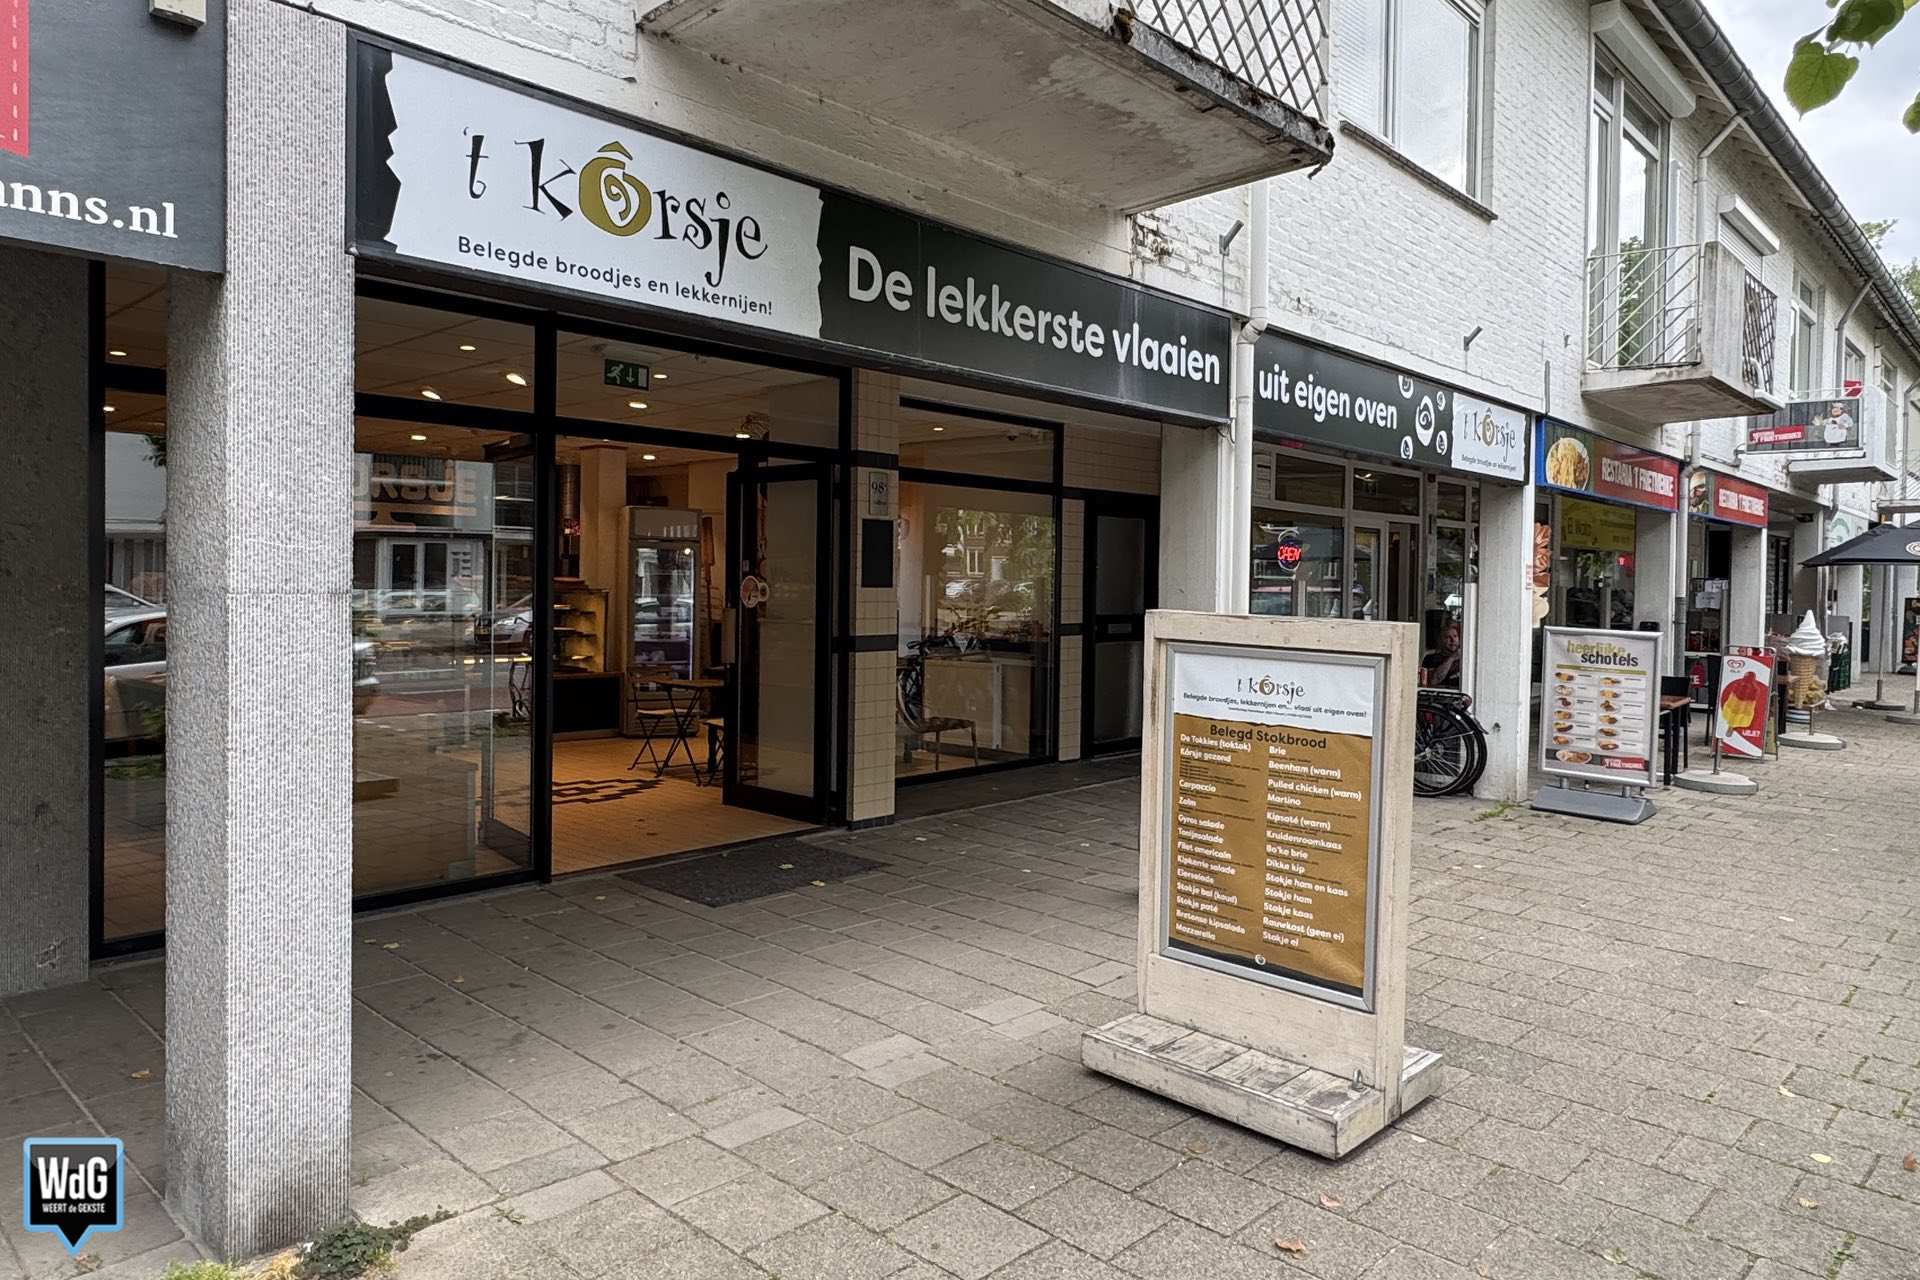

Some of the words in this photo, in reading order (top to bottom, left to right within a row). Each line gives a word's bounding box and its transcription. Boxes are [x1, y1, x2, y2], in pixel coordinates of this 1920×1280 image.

[0, 179, 178, 239] nns.nl
[458, 236, 548, 269] Belegde
[555, 255, 641, 289] broodjes
[648, 278, 669, 295] en
[675, 280, 773, 316] lekkernijen!
[848, 245, 913, 312] De
[926, 265, 1105, 358] lekkerste
[1112, 321, 1221, 385] vlaaien
[1258, 363, 1290, 404] uit
[1294, 373, 1350, 423] eigen
[1354, 396, 1398, 430] oven
[1278, 545, 1302, 561] OPEN
[1580, 650, 1639, 667] schotels
[1183, 692, 1207, 702] Belegde
[1324, 708, 1345, 717] eigen
[1346, 709, 1367, 718] oven!
[1180, 734, 1190, 742] De
[1210, 724, 1253, 741] Belegd
[1256, 730, 1327, 749] Stokbrood
[1203, 752, 1232, 763] gezond
[1269, 745, 1286, 755] Brie
[1268, 760, 1309, 772] Beenham
[1310, 765, 1341, 779] (warm)
[1179, 779, 1216, 793] Carpaccio
[1268, 779, 1294, 790] Pulled
[1295, 782, 1329, 795] chicken
[1331, 788, 1362, 801] (warm)
[1179, 796, 1196, 807] Zalm
[1267, 793, 1301, 806] Martino
[1178, 814, 1197, 825] Gyros
[1199, 819, 1225, 830] salade
[1300, 817, 1331, 831] (warm)
[1178, 841, 1193, 851] Filet
[1266, 830, 1342, 850] Kruidenroomkaas
[1290, 848, 1308, 859] brie
[1210, 863, 1236, 875] salade
[1266, 858, 1289, 870] Dikke
[1291, 863, 1305, 874] kip
[1177, 882, 1200, 895] Stokje
[1265, 873, 1292, 887] Stokje
[1294, 879, 1313, 890] ham
[1314, 884, 1325, 893] en
[1327, 885, 1348, 897] kaas
[1176, 895, 1199, 909] Stokje
[1265, 887, 1292, 901] Stokje
[1293, 893, 1312, 904] ham
[1264, 902, 1291, 916] Stokje
[1292, 908, 1313, 919] kaas
[1209, 917, 1246, 934] kipsalade
[1263, 916, 1305, 933] Rauwkost
[1306, 926, 1331, 939] (geen
[1263, 931, 1289, 945] Stokje
